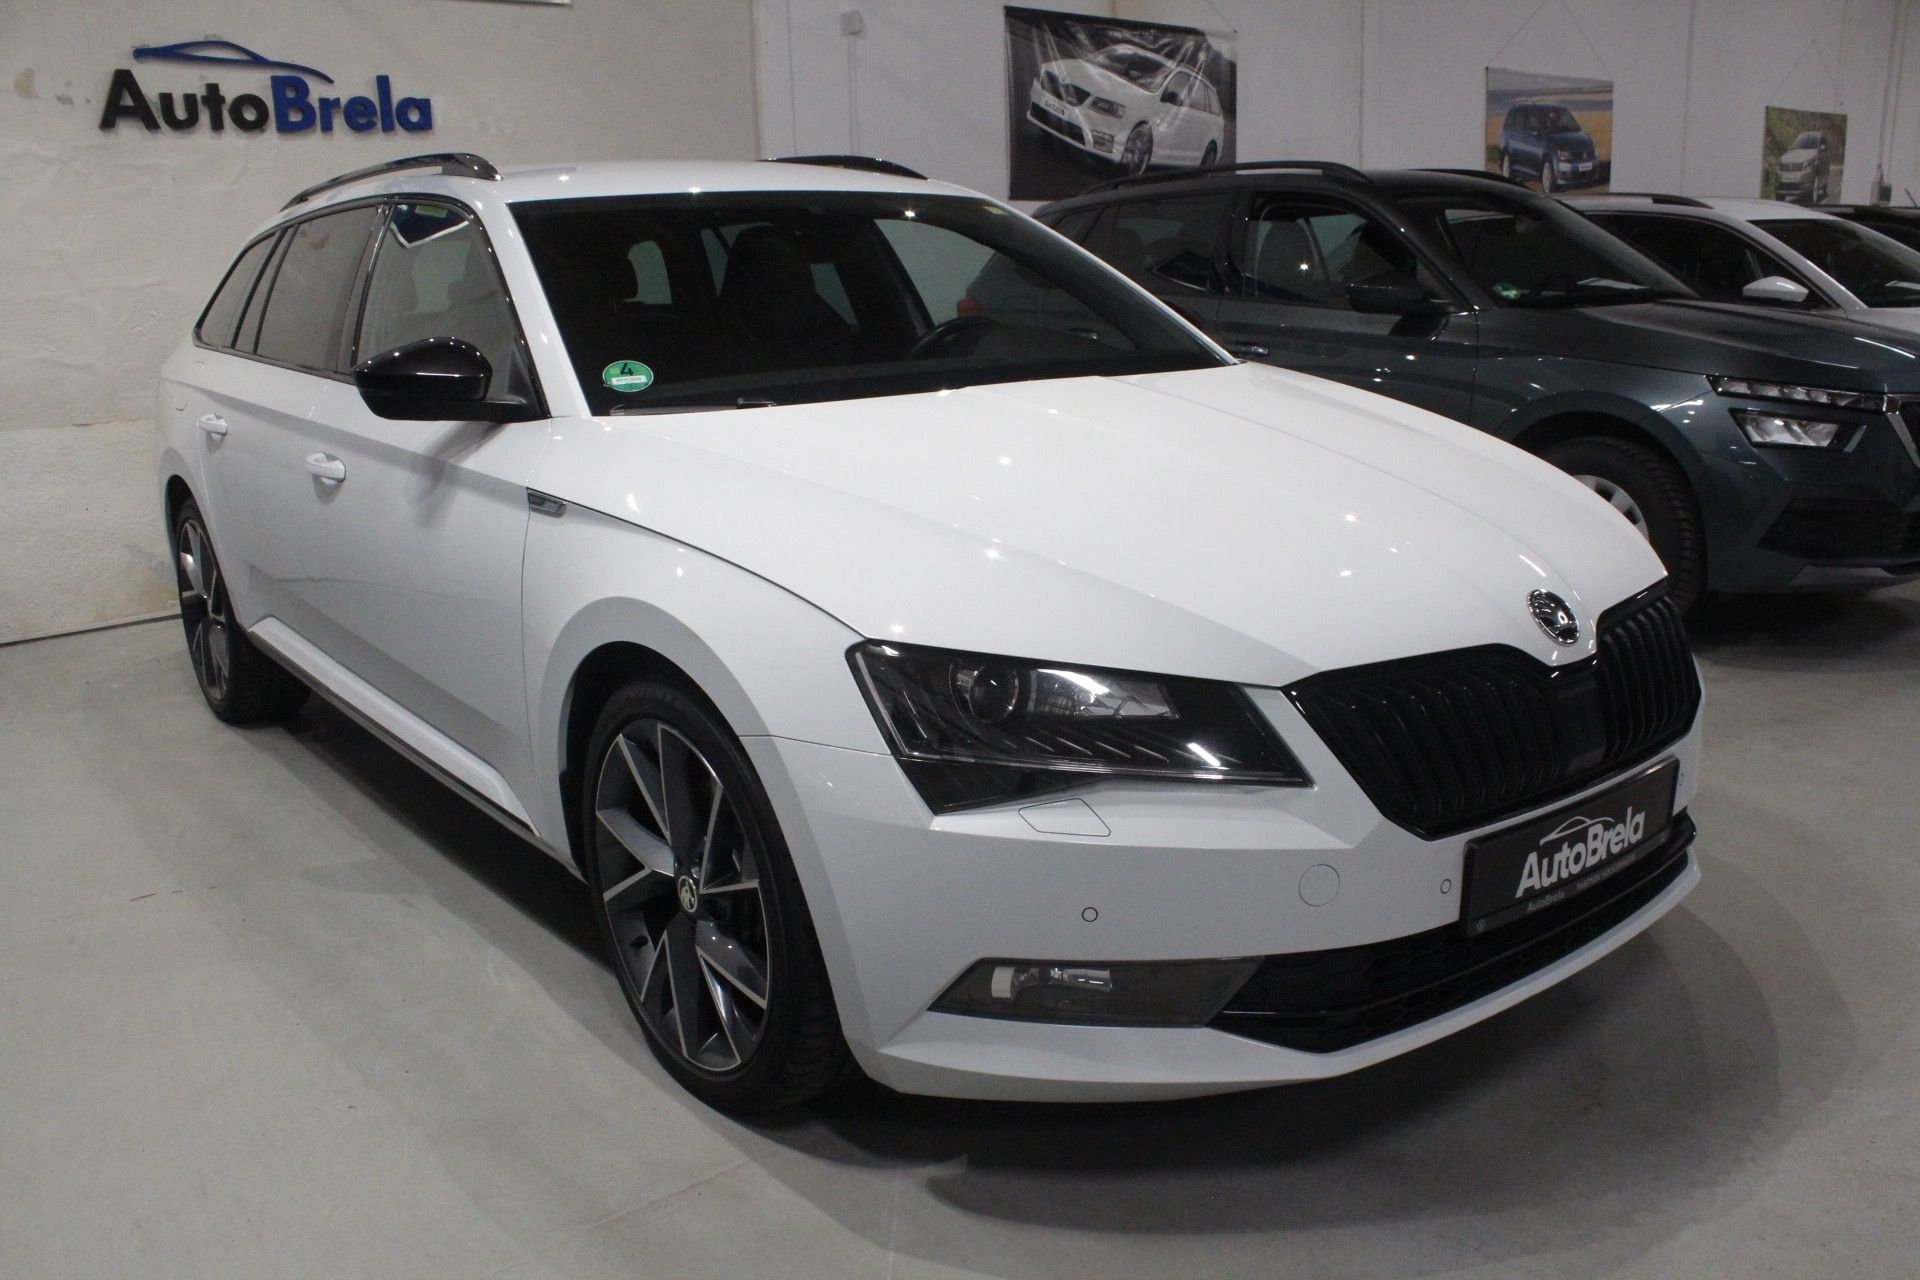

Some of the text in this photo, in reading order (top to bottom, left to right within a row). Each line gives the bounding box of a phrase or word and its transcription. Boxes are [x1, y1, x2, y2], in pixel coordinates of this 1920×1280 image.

[100, 69, 432, 133] AutoBrela
[620, 362, 634, 376] 4
[1515, 806, 1646, 899] AutoBrela
